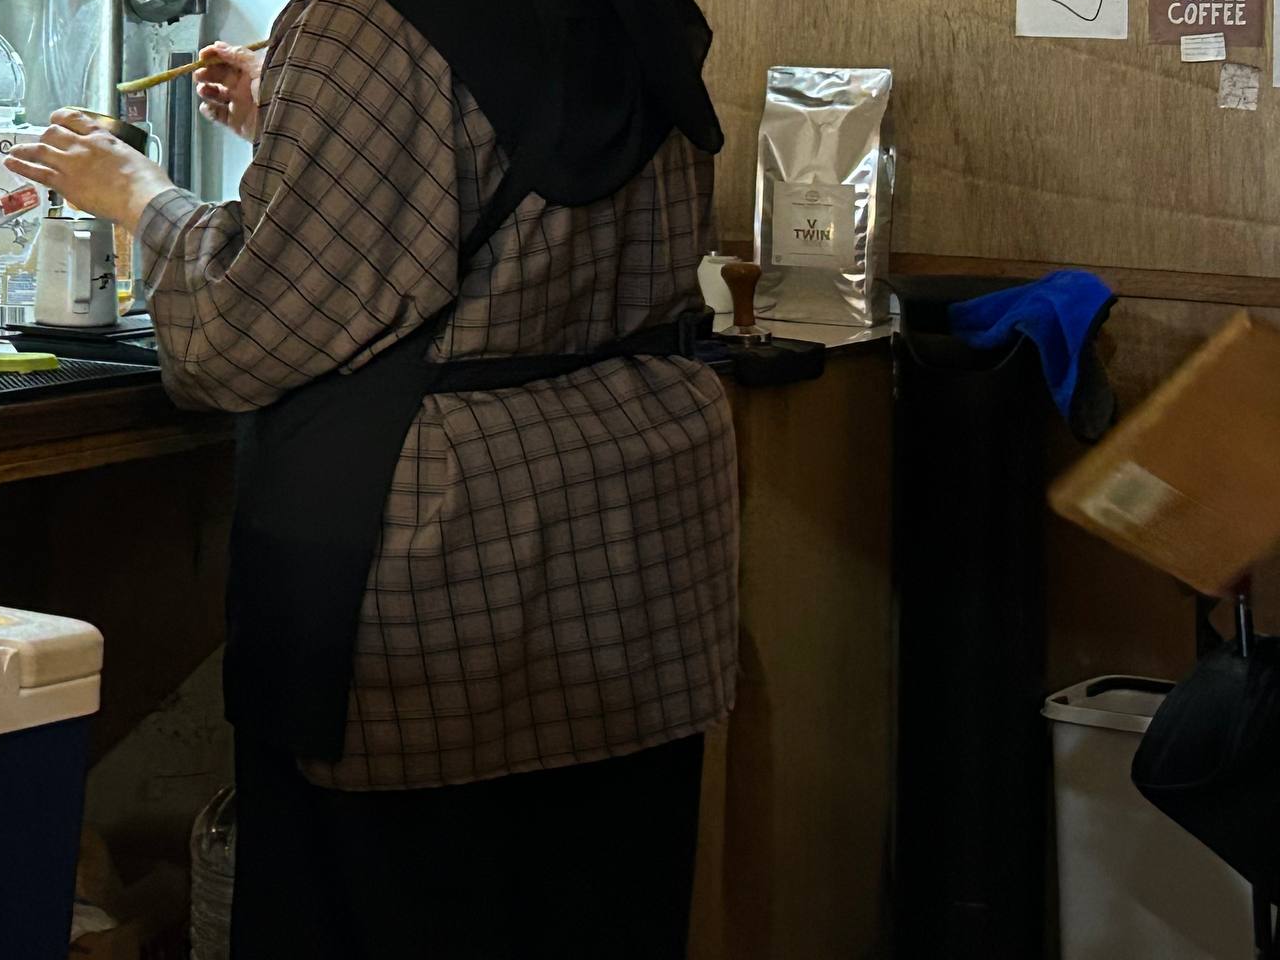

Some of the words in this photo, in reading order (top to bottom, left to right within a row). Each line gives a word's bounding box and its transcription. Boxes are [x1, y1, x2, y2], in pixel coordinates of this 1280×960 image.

[1168, 3, 1246, 25] COFFEE
[807, 218, 817, 229] V
[793, 229, 831, 241] TWIN
